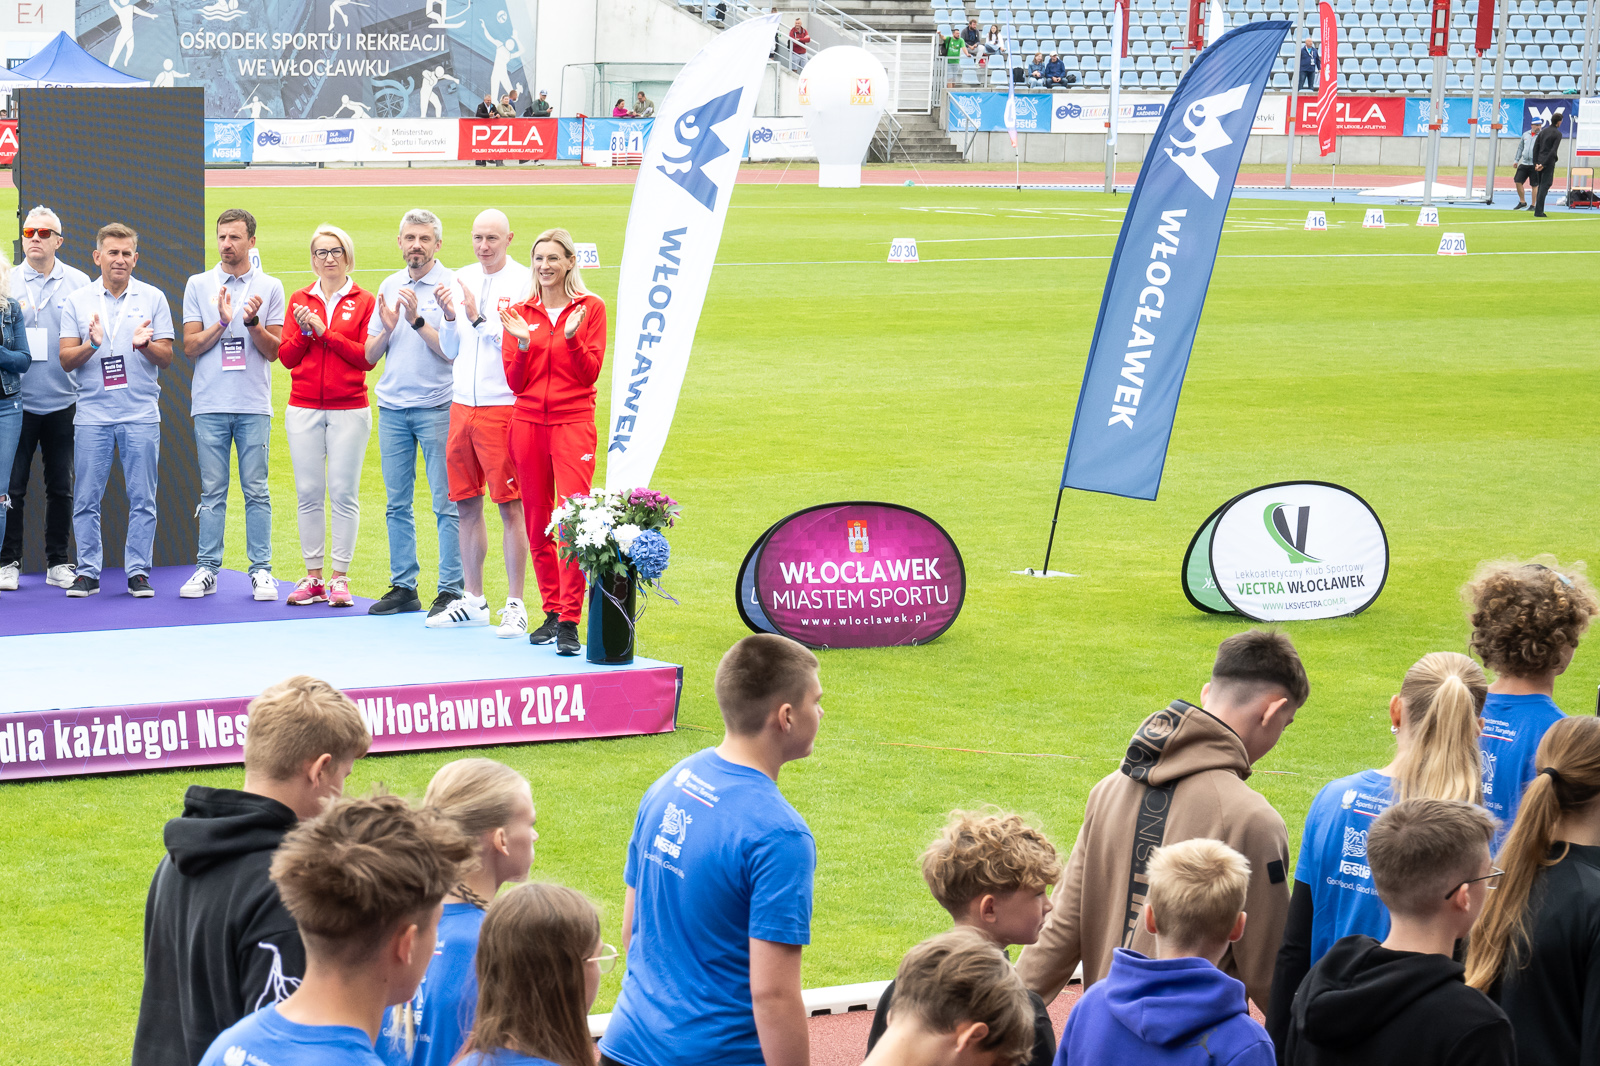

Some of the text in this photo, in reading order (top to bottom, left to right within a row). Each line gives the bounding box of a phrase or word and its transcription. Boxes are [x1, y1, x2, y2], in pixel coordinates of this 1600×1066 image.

[17, 2, 44, 24] E1
[180, 27, 446, 52] OŚRODEK SPORTU I REKREACJI
[238, 58, 390, 77] WE WŁOCŁAWKU
[1256, 113, 1275, 122] styki
[392, 128, 433, 137] Ministerstwo
[472, 125, 544, 147] PZLA
[391, 138, 414, 148] Sportu
[419, 138, 447, 149] Turystyki
[632, 137, 639, 151] 1
[1312, 216, 1325, 227] 16
[1370, 214, 1383, 224] 14
[1424, 213, 1437, 223] 12
[904, 245, 917, 258] 30
[1453, 239, 1465, 251] 20
[583, 250, 598, 263] 35
[1107, 208, 1188, 430] WŁOCŁAWEK
[607, 226, 688, 454] WŁOCŁAWEK
[779, 557, 942, 585] WŁOCŁAWEK
[1234, 563, 1365, 581] Lekkoatletyczny Klub Sportowy
[1236, 580, 1285, 596] VECTRA
[1287, 574, 1366, 594] WŁOCŁAWEK
[772, 588, 865, 611] MIASTEM
[869, 584, 950, 609] SPORTU
[1261, 597, 1348, 611] WWW.LKSVECTRA.COM.PL
[800, 611, 928, 627] www.wloclawek.pl
[52, 707, 191, 763] każdego!
[196, 708, 248, 750] Nes
[357, 688, 513, 737] Włocławek
[520, 683, 587, 726] 2024
[1354, 801, 1373, 812] Sportu
